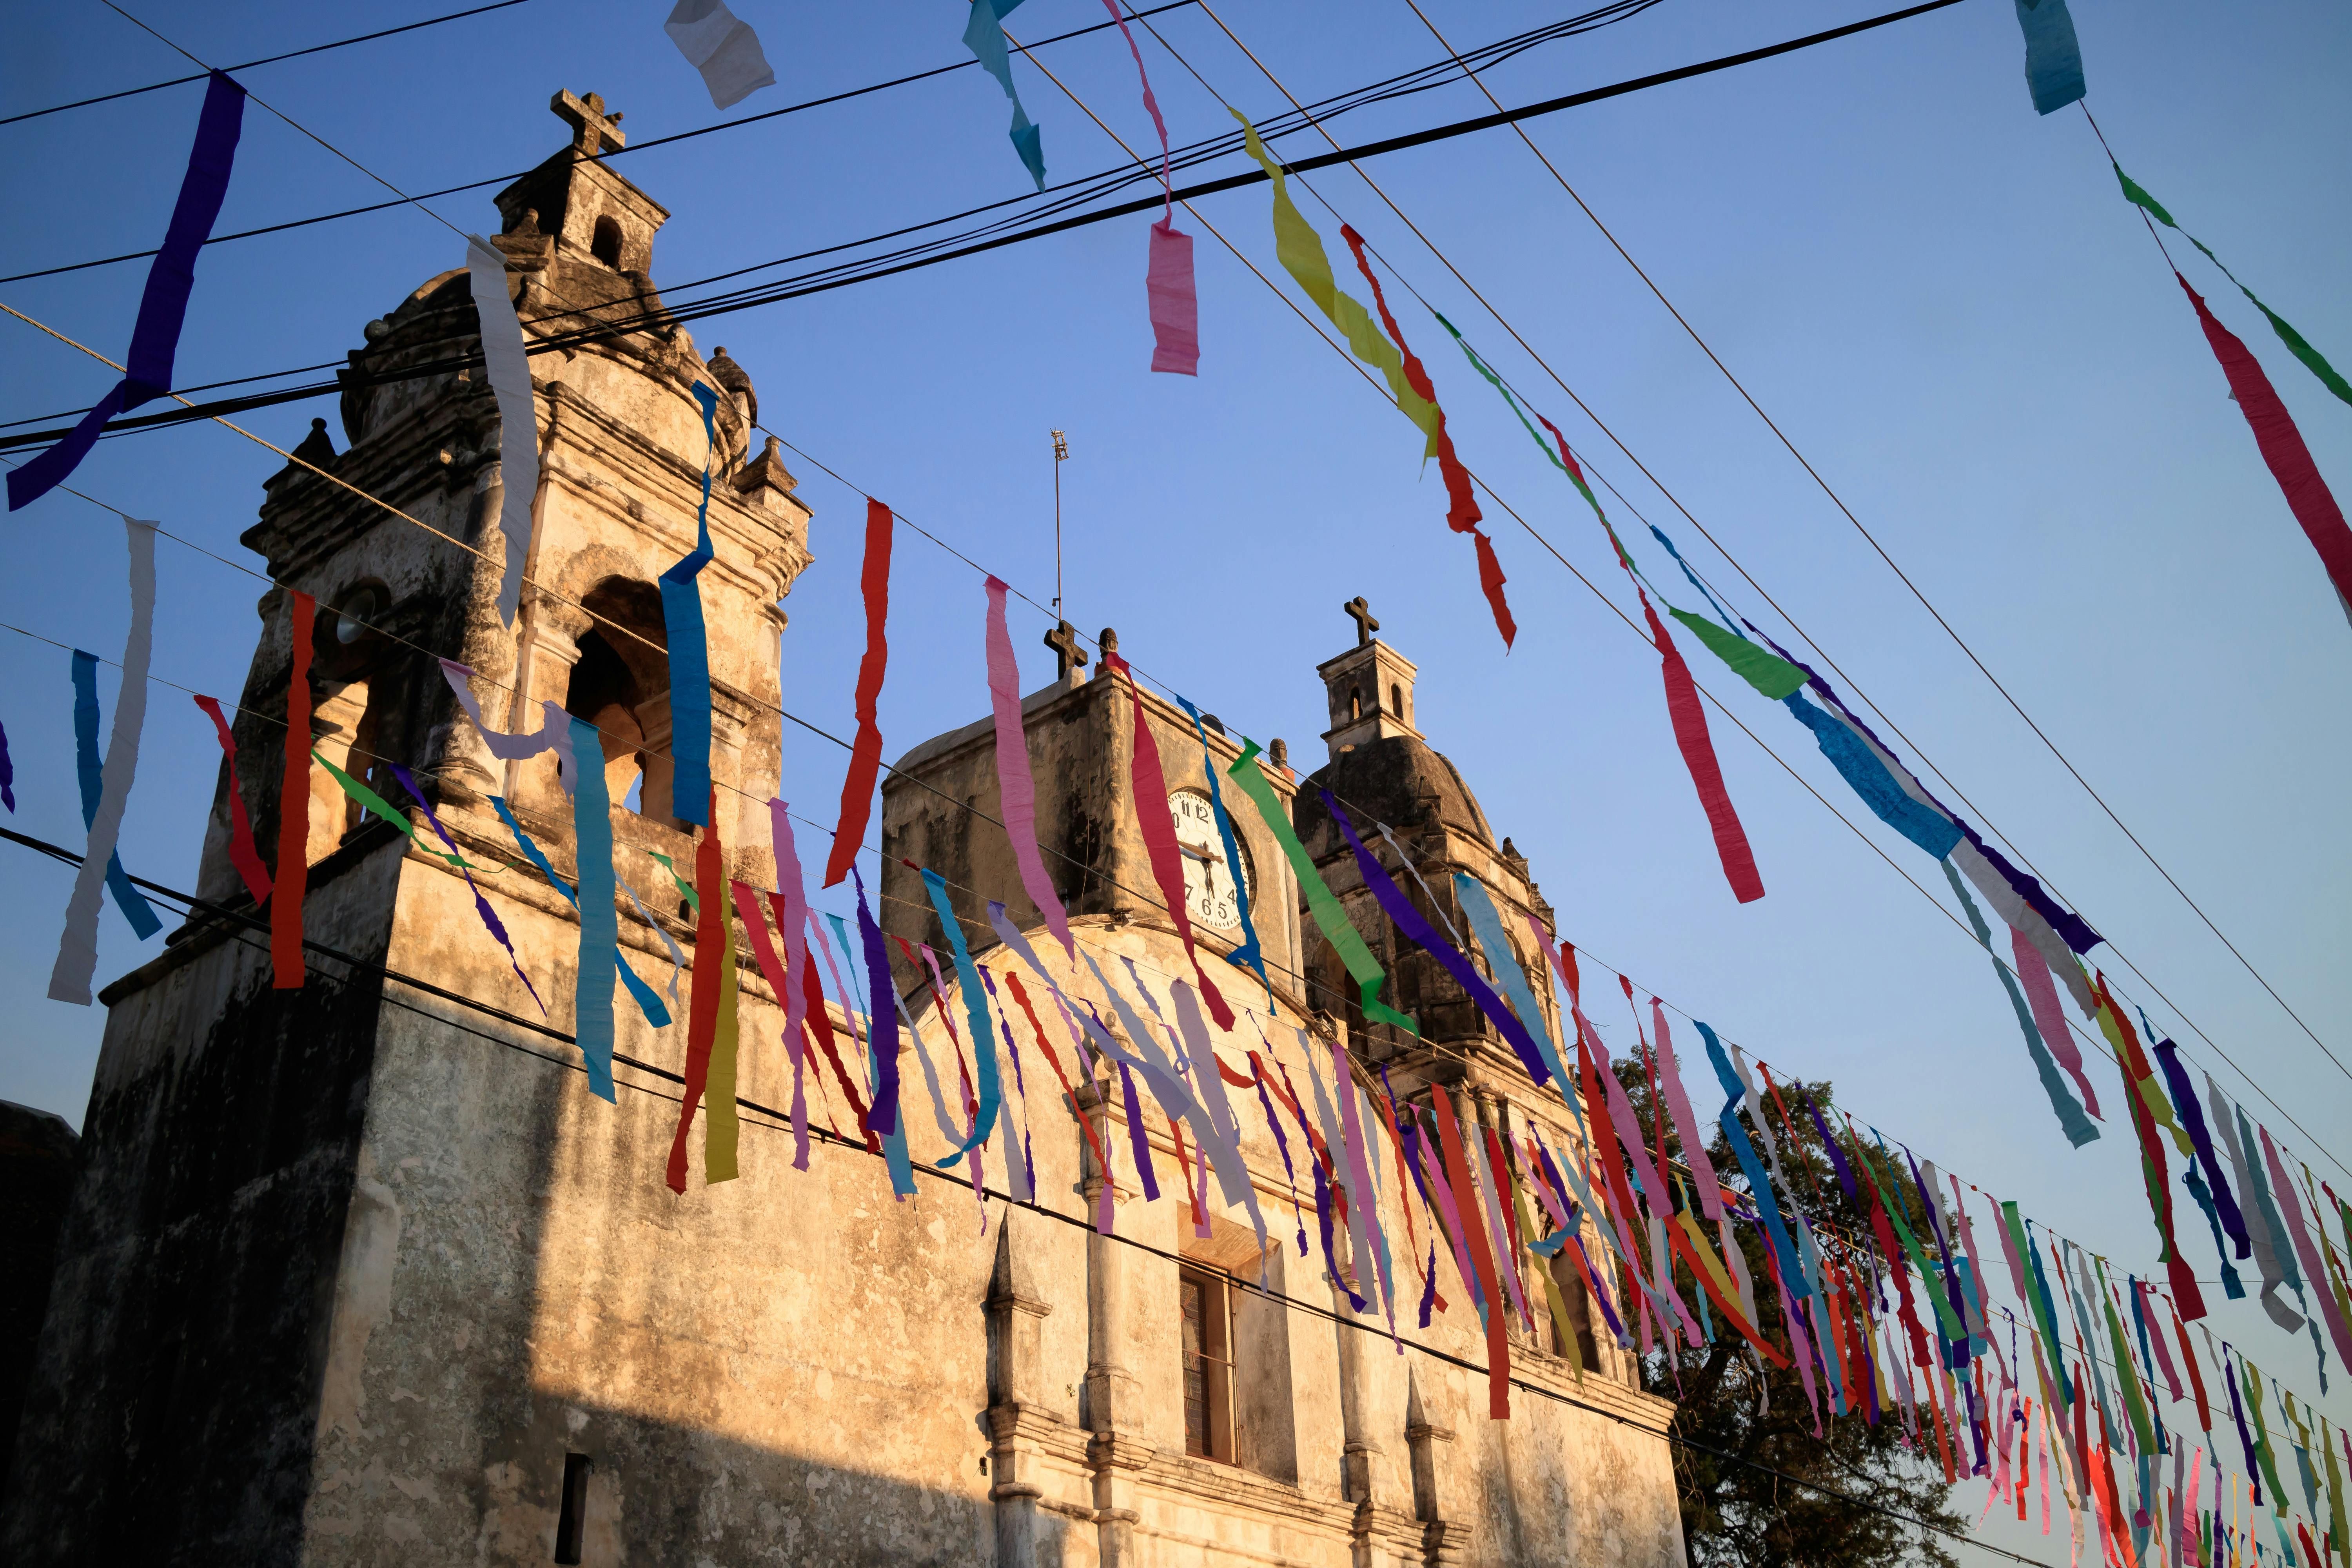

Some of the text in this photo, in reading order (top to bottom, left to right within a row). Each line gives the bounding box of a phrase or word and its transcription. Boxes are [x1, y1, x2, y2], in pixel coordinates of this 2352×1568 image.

[1181, 800, 1191, 817] 11
[1195, 804, 1209, 824] 12
[1170, 810, 1180, 828] 0
[1185, 883, 1194, 900] 7
[1227, 889, 1236, 905] 4
[1202, 898, 1211, 916] 6
[1218, 902, 1227, 919] 5
